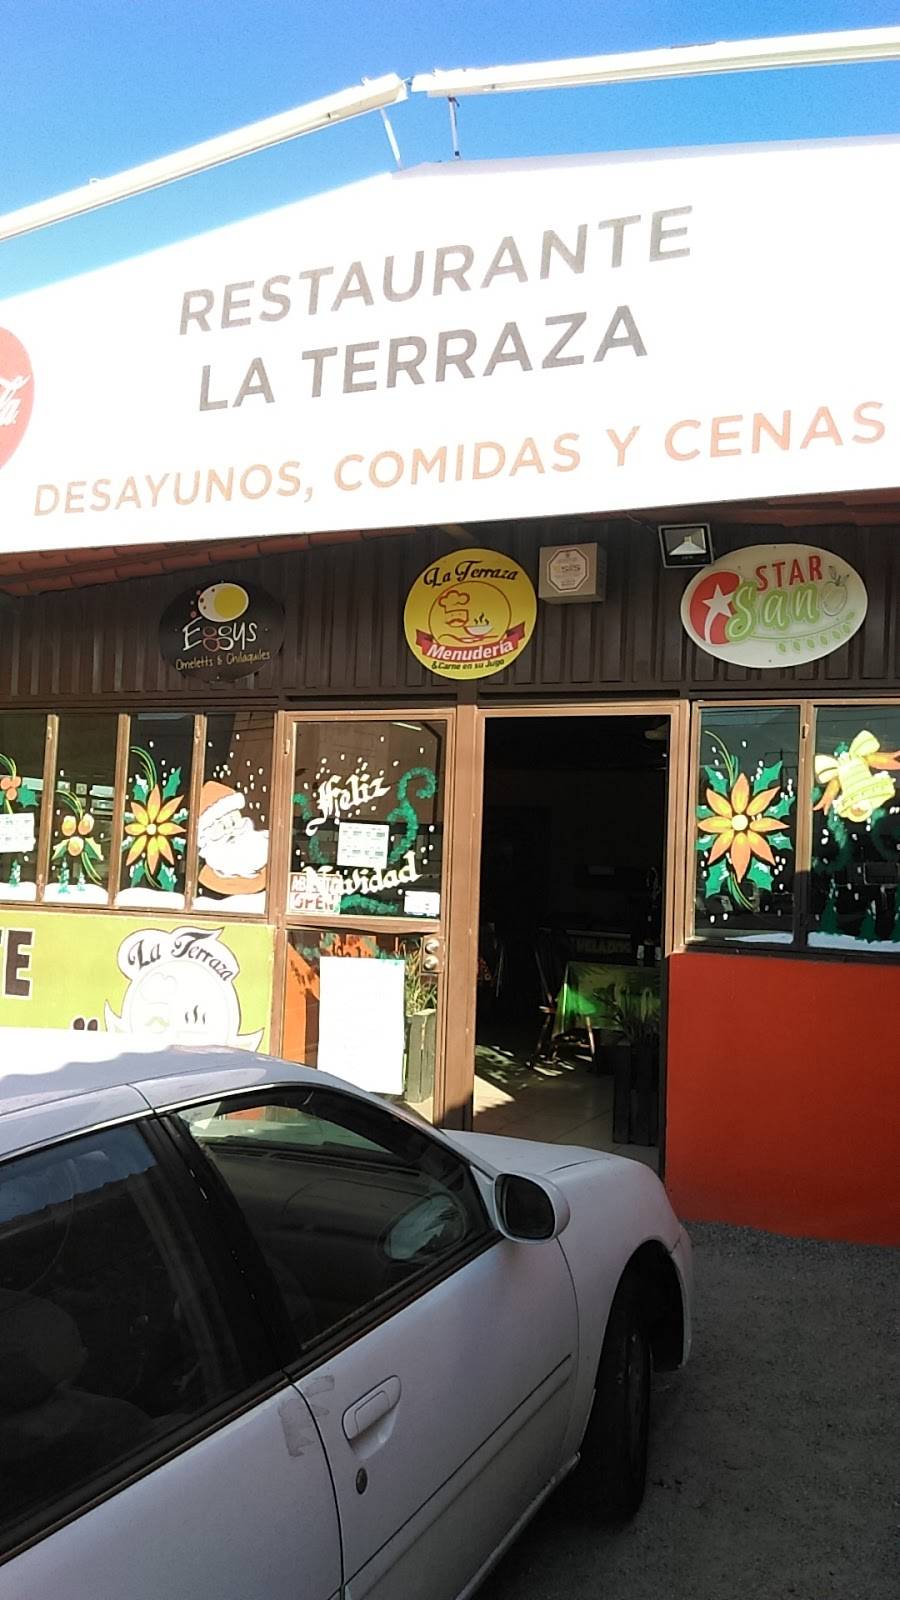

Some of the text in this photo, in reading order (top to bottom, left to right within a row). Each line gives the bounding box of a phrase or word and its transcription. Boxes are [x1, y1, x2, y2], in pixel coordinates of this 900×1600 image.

[179, 205, 693, 336] RESTAURANTE
[199, 304, 648, 411] LA TERRAZA
[33, 400, 887, 516] DESAYUNOS, COMIDAS Y CENAS
[423, 560, 519, 588] La Terraza
[754, 554, 824, 592] STAR
[305, 774, 391, 837] Feliz
[127, 931, 234, 982] La Terraza
